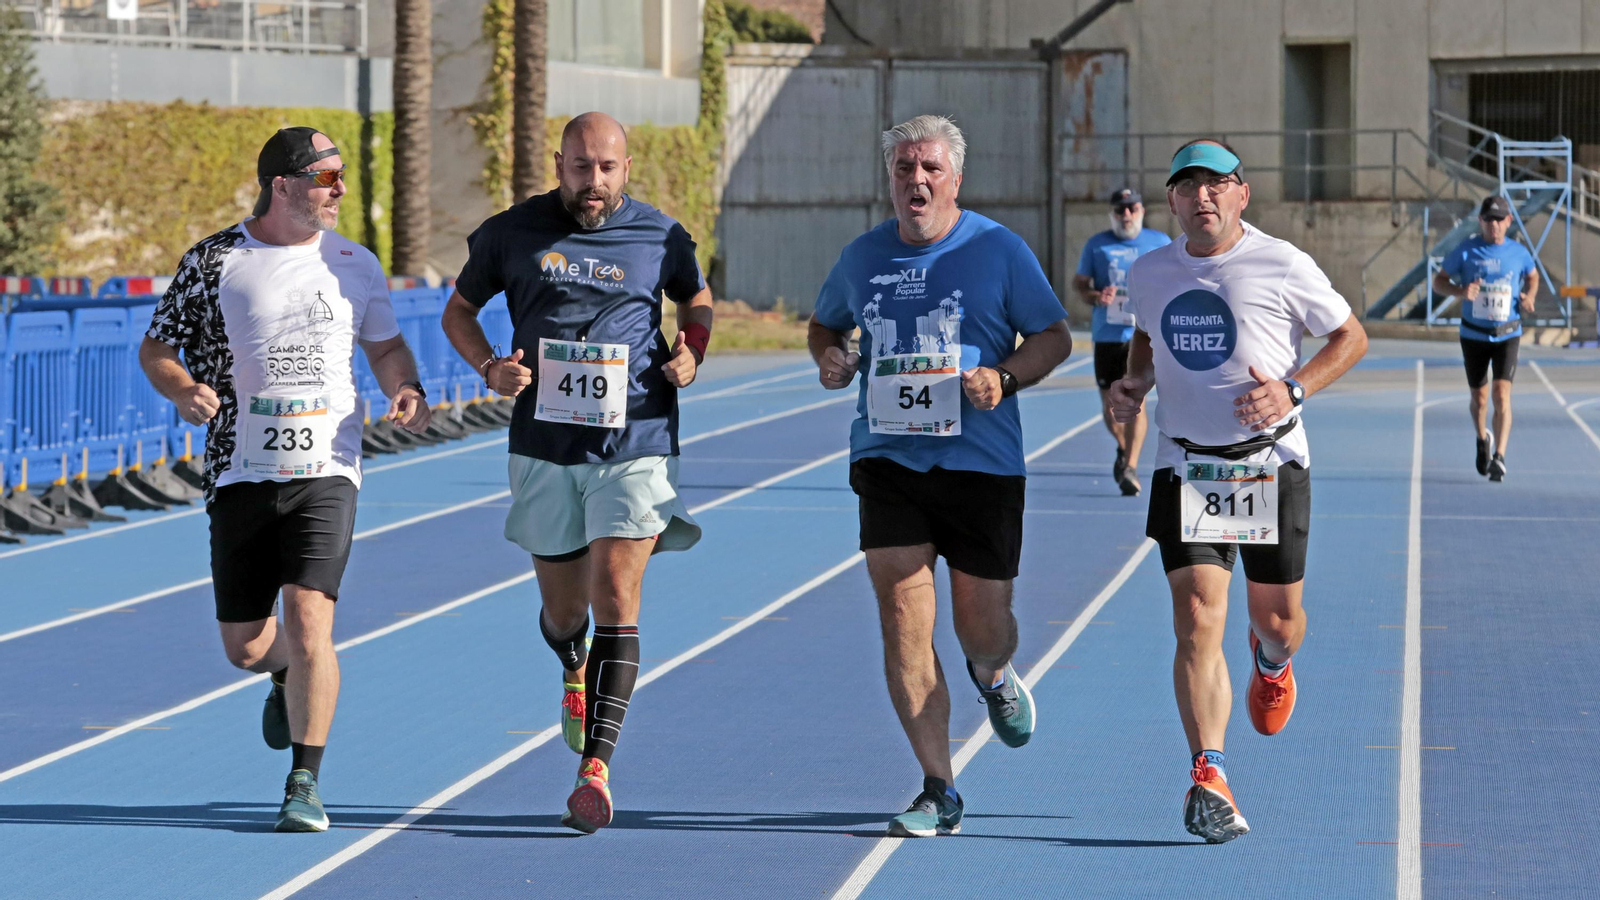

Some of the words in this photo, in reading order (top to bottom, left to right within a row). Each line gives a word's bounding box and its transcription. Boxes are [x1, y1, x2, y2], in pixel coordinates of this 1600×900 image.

[540, 275, 573, 283] Deporte
[600, 280, 624, 288] Todos
[899, 268, 927, 282] XLI
[1482, 297, 1503, 308] 314
[1170, 314, 1224, 326] MENCANTA
[268, 345, 306, 353] CAMINO
[309, 345, 325, 353] DEL
[1172, 332, 1227, 351] JEREZ
[557, 373, 609, 400] 419
[898, 385, 933, 410] 54
[262, 427, 314, 451] 233
[1205, 492, 1254, 516] 811
